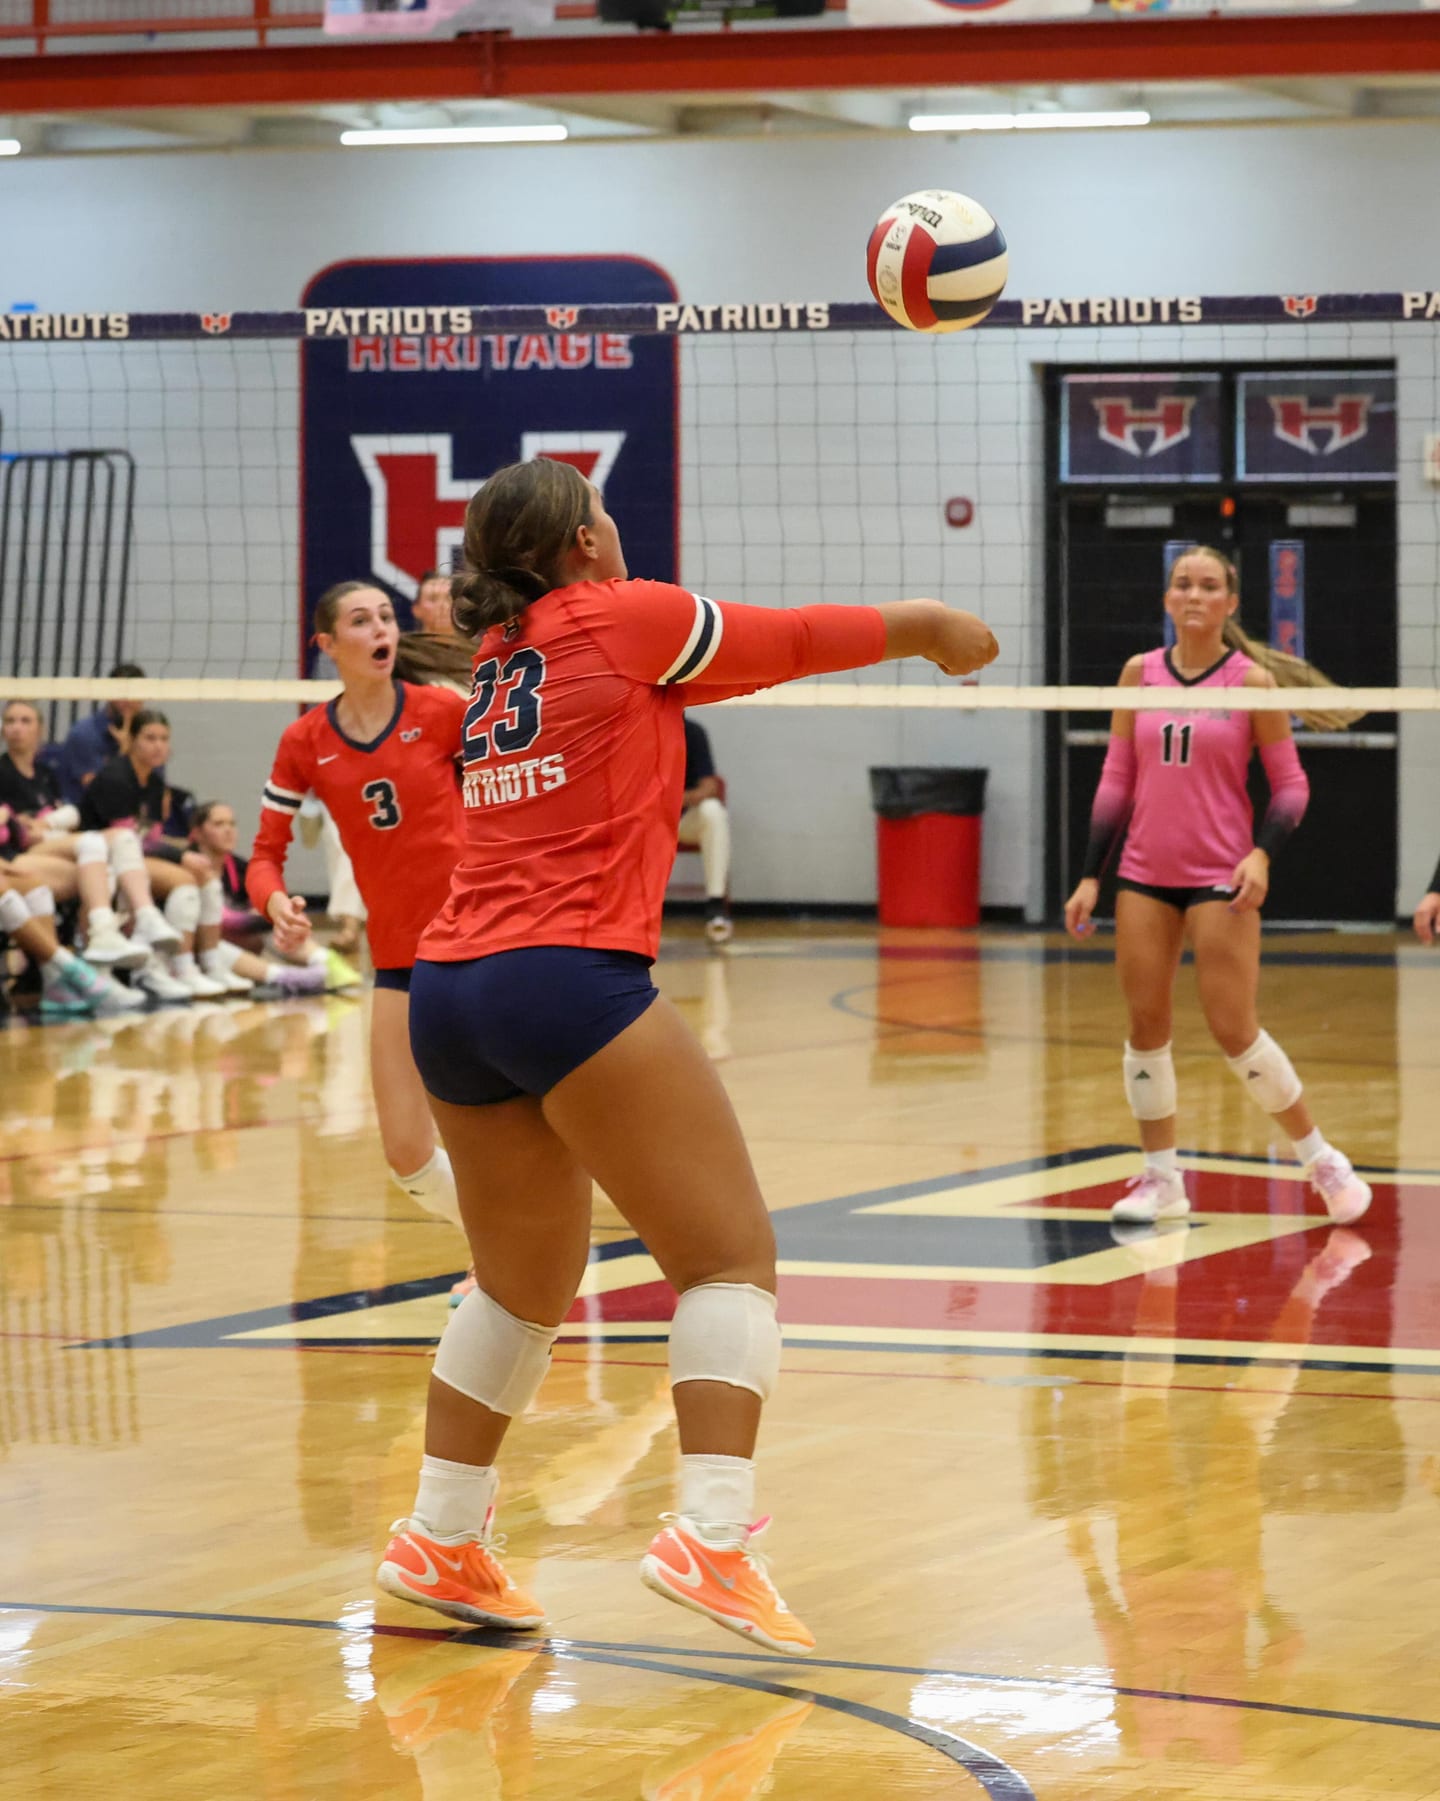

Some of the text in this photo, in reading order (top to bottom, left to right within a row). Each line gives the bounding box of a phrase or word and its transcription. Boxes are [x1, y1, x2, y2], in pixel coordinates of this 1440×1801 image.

[305, 307, 473, 336] PATRIOTS
[656, 303, 830, 331] PATRIOTS
[1022, 297, 1202, 325] PATRIOTS
[348, 335, 634, 373] HERITAGE
[461, 646, 547, 767] 23
[1160, 720, 1193, 767] 11
[361, 777, 402, 830] 3
